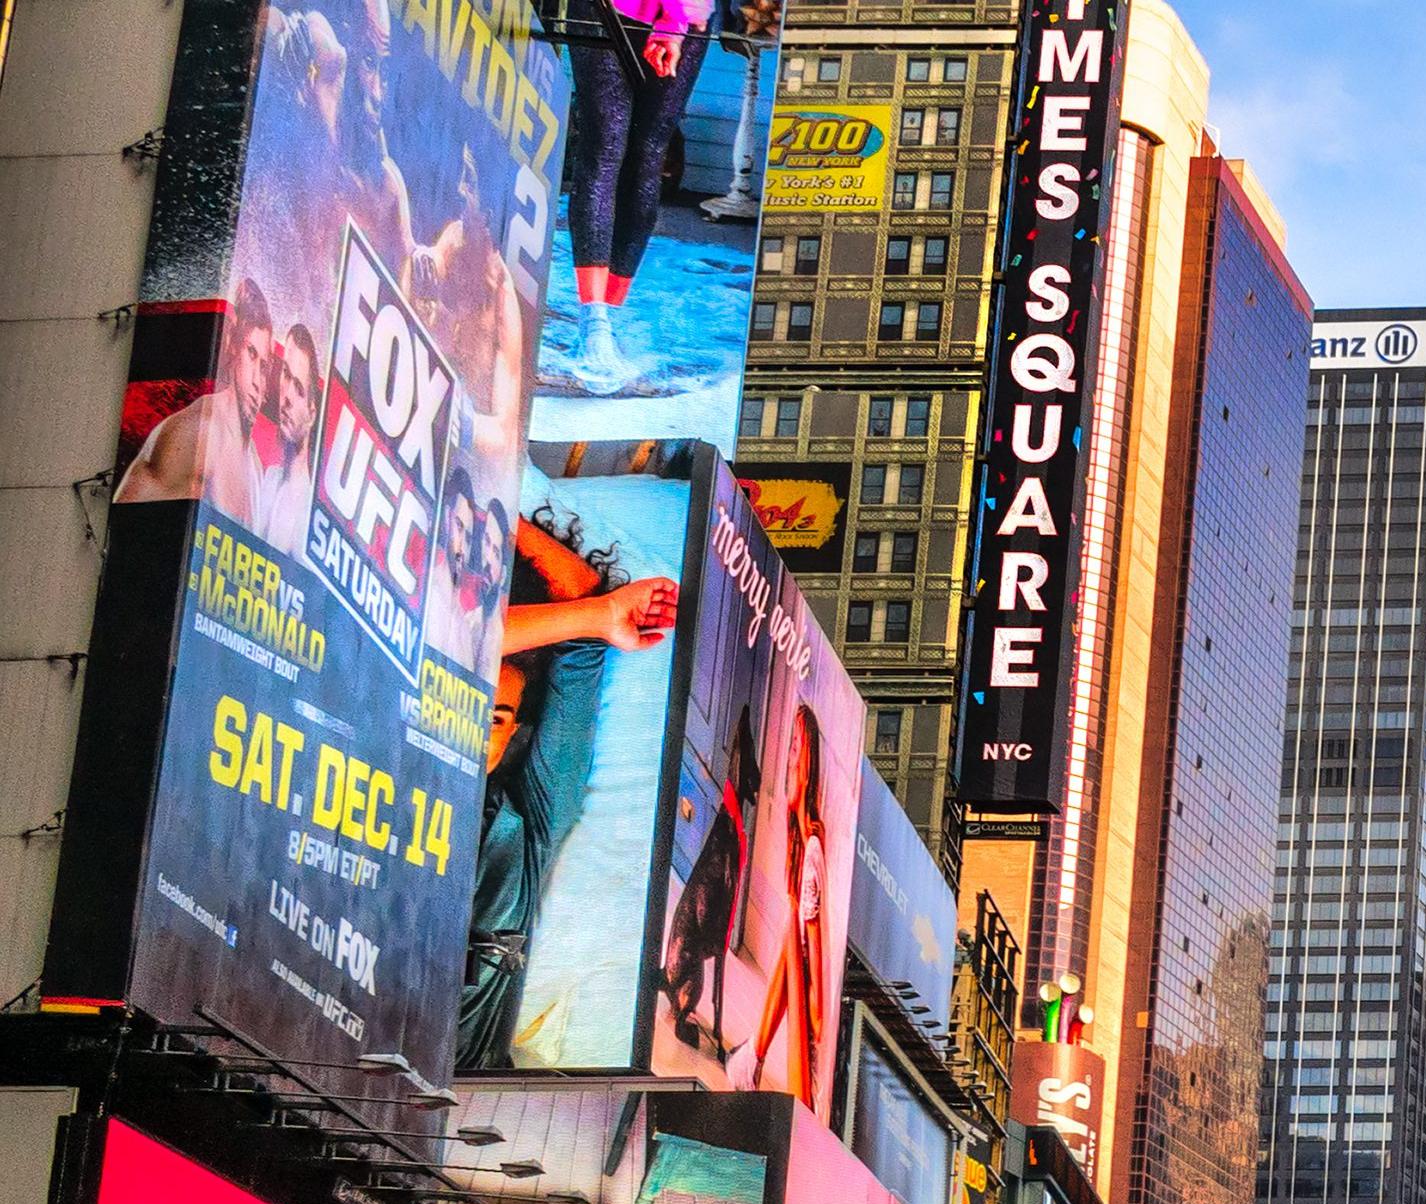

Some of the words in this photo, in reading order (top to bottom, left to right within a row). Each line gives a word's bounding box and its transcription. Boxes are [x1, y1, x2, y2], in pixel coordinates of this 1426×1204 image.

[780, 175, 835, 189] York's
[840, 175, 864, 189] #1
[811, 192, 878, 206] Station
[334, 238, 454, 498] FOX
[323, 404, 430, 596] UFC
[989, 263, 1077, 689] SQUARE
[198, 563, 326, 675] McDONALD
[203, 523, 281, 602] FABER
[279, 581, 305, 619] VS
[309, 508, 419, 663] SATURDAY
[713, 503, 771, 649] merry
[193, 612, 274, 674] BANTAMWEIGHT
[274, 654, 300, 684] BOUT
[418, 699, 485, 758] BROWN
[982, 742, 1033, 761] NYC
[208, 694, 305, 817] SAT.
[312, 742, 398, 856] DEC.
[404, 787, 453, 877] 14
[288, 829, 339, 877] 8/5PM
[339, 845, 381, 891] ET/PT
[856, 832, 909, 916] CHEVROLET
[269, 879, 311, 943] LIVE
[311, 912, 336, 963] ON
[335, 916, 381, 996] FOX
